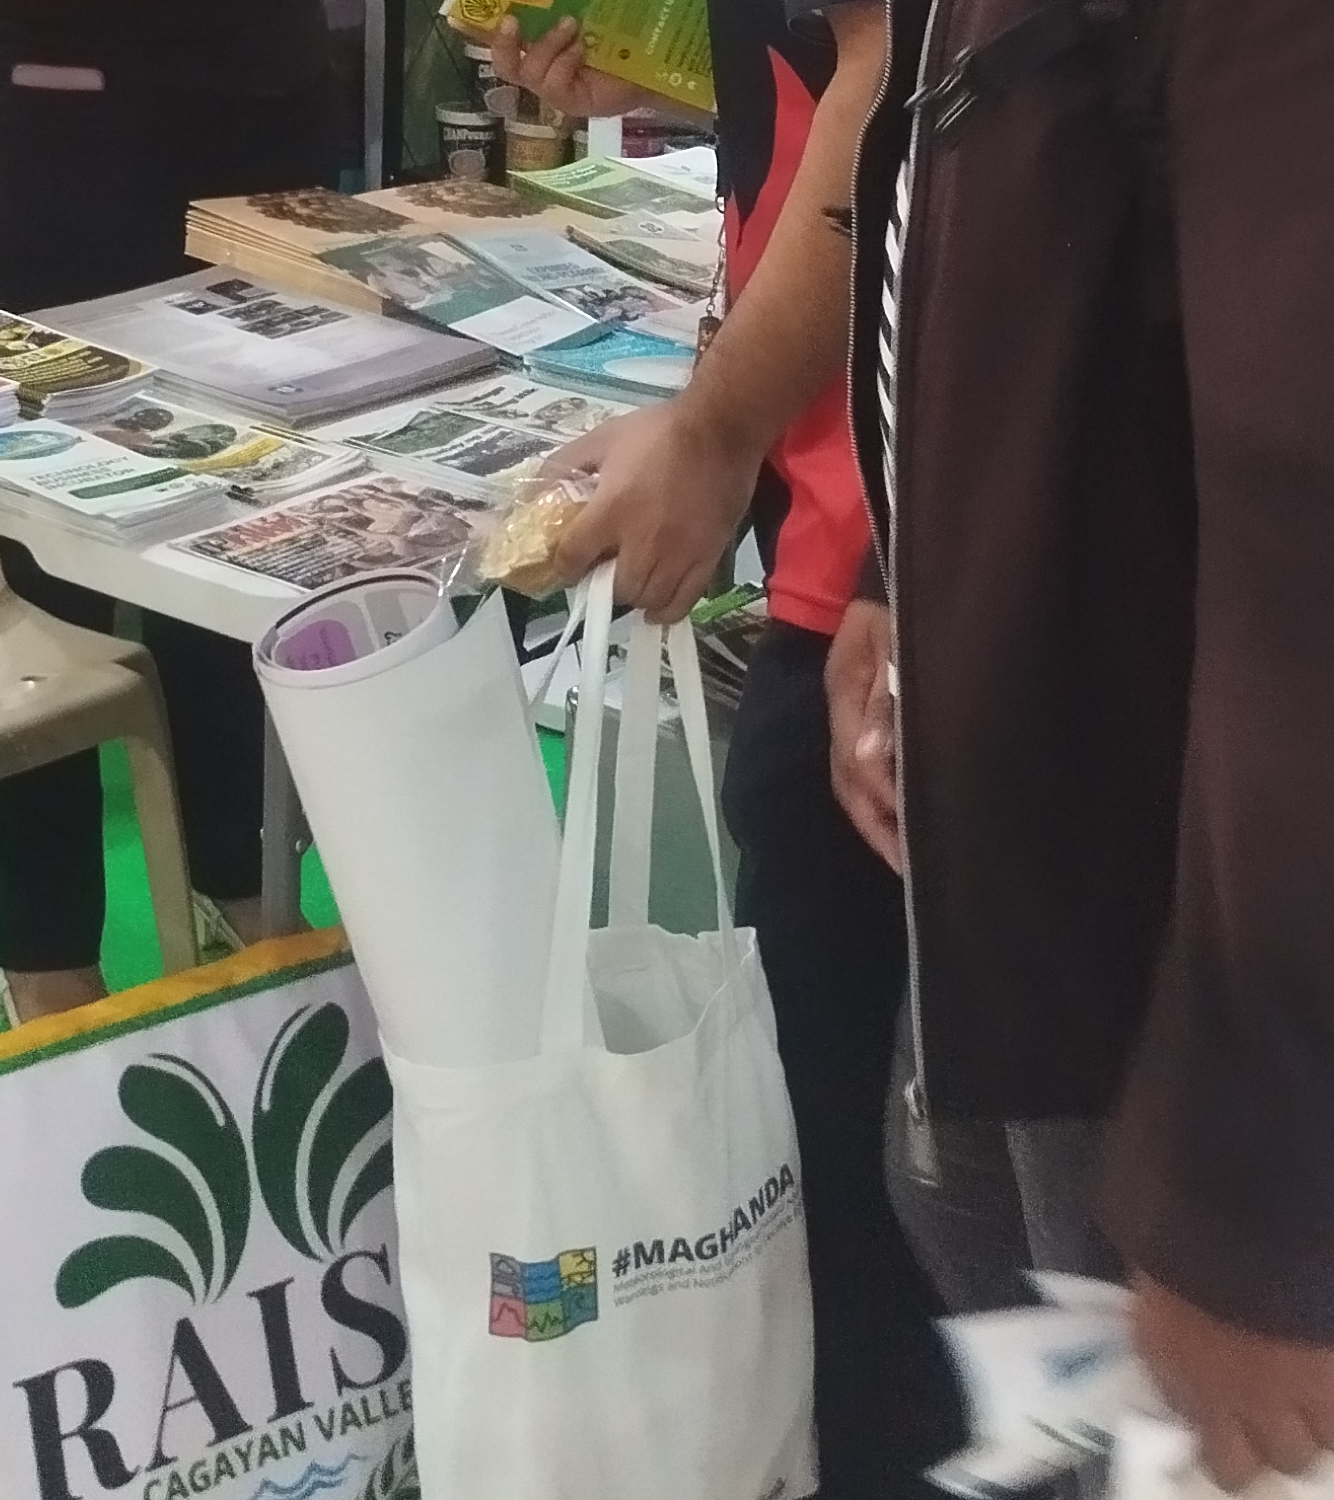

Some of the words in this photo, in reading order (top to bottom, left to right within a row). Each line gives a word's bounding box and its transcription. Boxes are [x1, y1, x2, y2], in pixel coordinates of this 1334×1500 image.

[612, 1163, 795, 1278] #MAGHANDA
[13, 1243, 409, 1500] RAIS
[143, 1424, 307, 1500] CAGAYAN
[311, 1382, 413, 1442] VALLE
